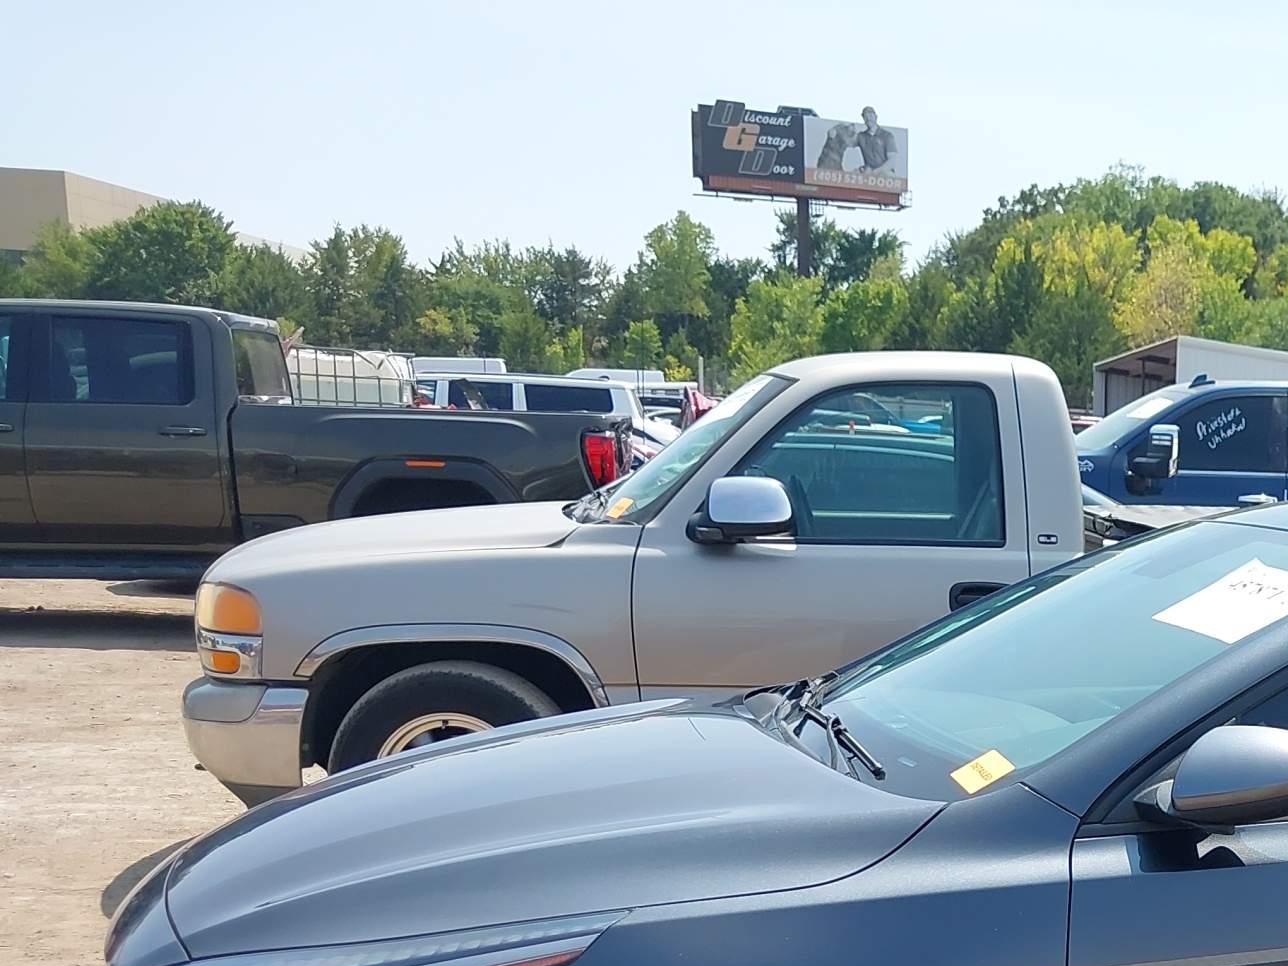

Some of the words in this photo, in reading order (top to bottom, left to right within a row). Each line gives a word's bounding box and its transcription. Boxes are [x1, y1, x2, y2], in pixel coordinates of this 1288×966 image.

[707, 99, 792, 127] Discount
[722, 122, 796, 152] Garage
[738, 147, 795, 176] Door
